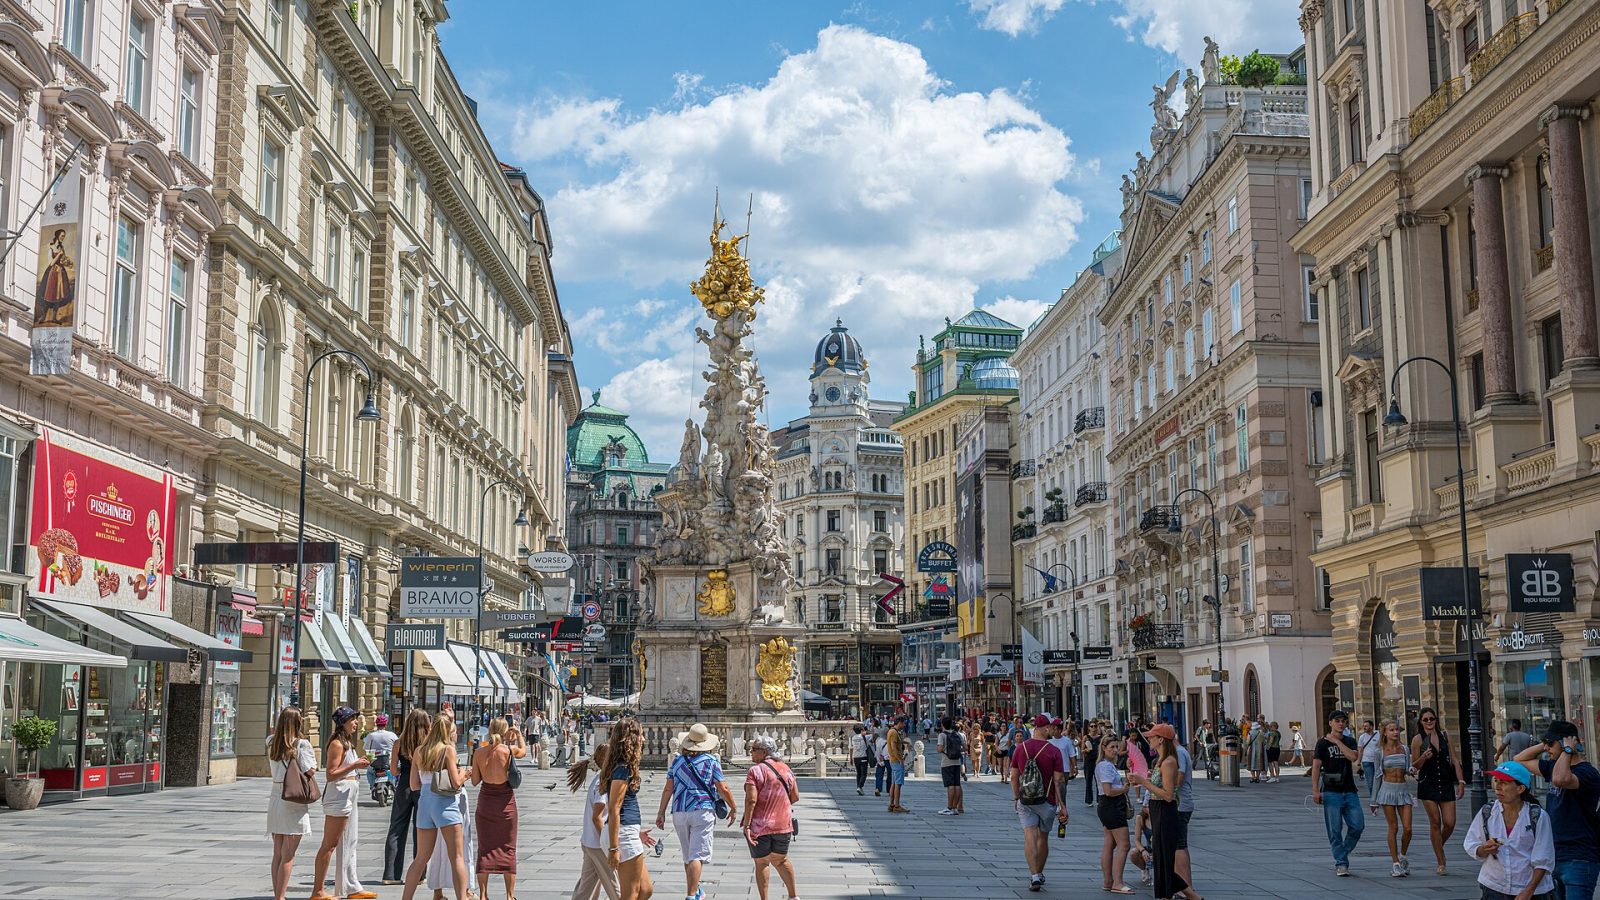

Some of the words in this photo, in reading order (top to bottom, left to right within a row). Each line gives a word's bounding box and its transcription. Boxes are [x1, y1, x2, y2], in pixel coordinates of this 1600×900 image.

[90, 499, 132, 522] PISCHINGER
[1521, 570, 1561, 597] BB
[407, 591, 473, 605] BRAMO
[1432, 605, 1477, 616] MaxMaa
[508, 631, 541, 639] swatch
